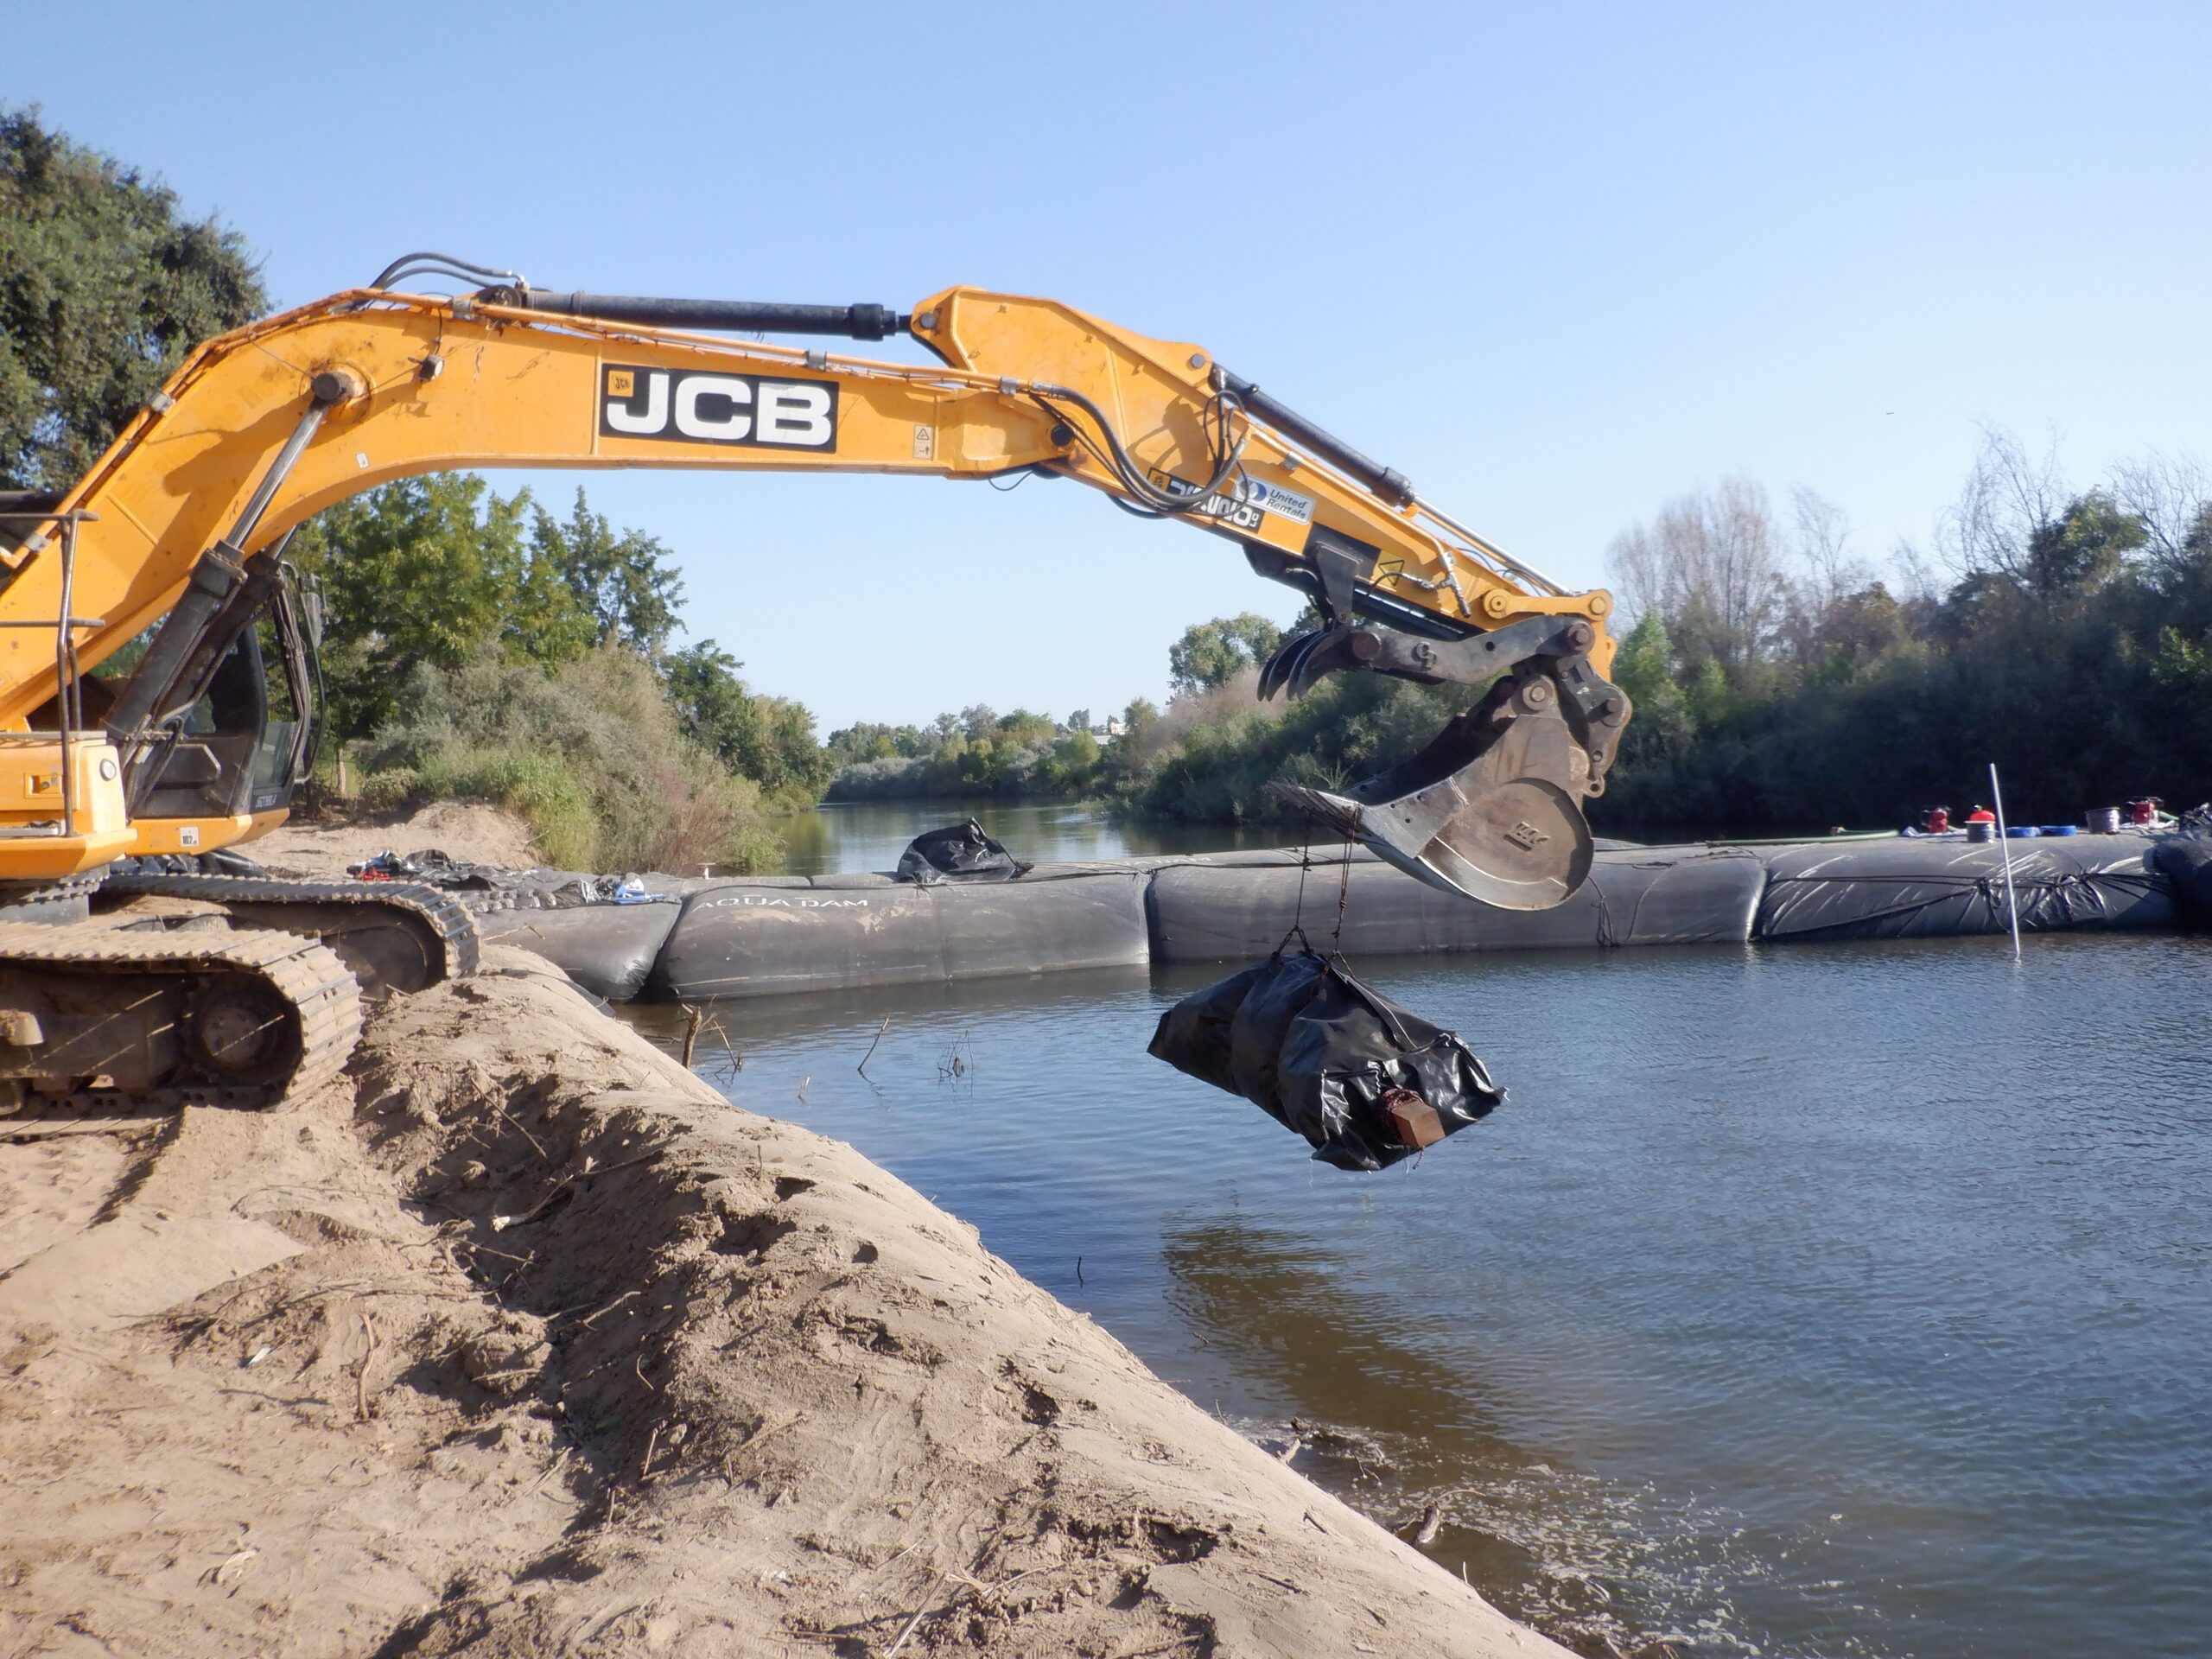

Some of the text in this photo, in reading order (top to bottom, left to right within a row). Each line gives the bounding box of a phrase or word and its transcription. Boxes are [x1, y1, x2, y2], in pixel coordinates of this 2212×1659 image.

[607, 372, 831, 446] JCB
[1270, 489, 1306, 508] United
[1266, 499, 1306, 518] Rentals
[692, 895, 868, 912] AQUA DAM
